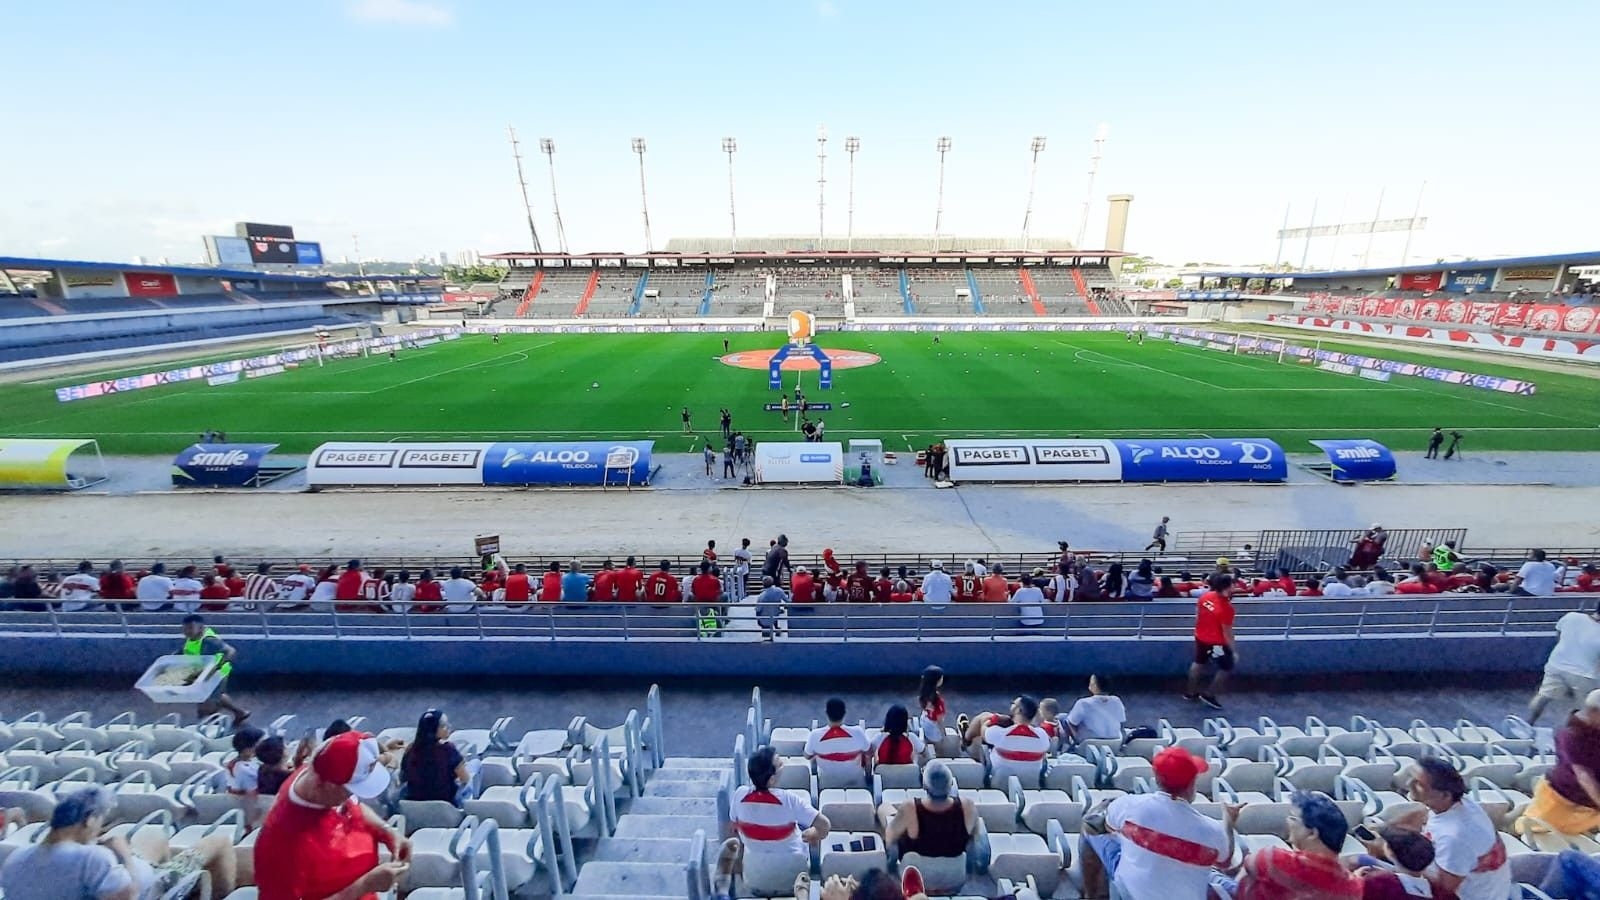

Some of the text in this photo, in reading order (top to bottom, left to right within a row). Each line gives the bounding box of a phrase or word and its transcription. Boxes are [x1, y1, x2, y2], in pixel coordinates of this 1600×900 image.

[1455, 273, 1487, 285] smile
[101, 375, 145, 394] 1XBET
[155, 369, 193, 385] 1XBET
[1413, 364, 1454, 382] 1XBET
[1460, 372, 1508, 391] 1XBET
[188, 450, 249, 466] smile
[325, 453, 387, 462] PAGBET
[409, 453, 470, 462] PAGBET
[530, 450, 590, 463] ALOO
[963, 450, 1020, 459] PAGBET
[1043, 449, 1099, 458] PAGBET
[1161, 446, 1221, 459] ALOO
[1335, 446, 1381, 459] smile
[655, 582, 666, 596] 10
[963, 579, 974, 592] 10
